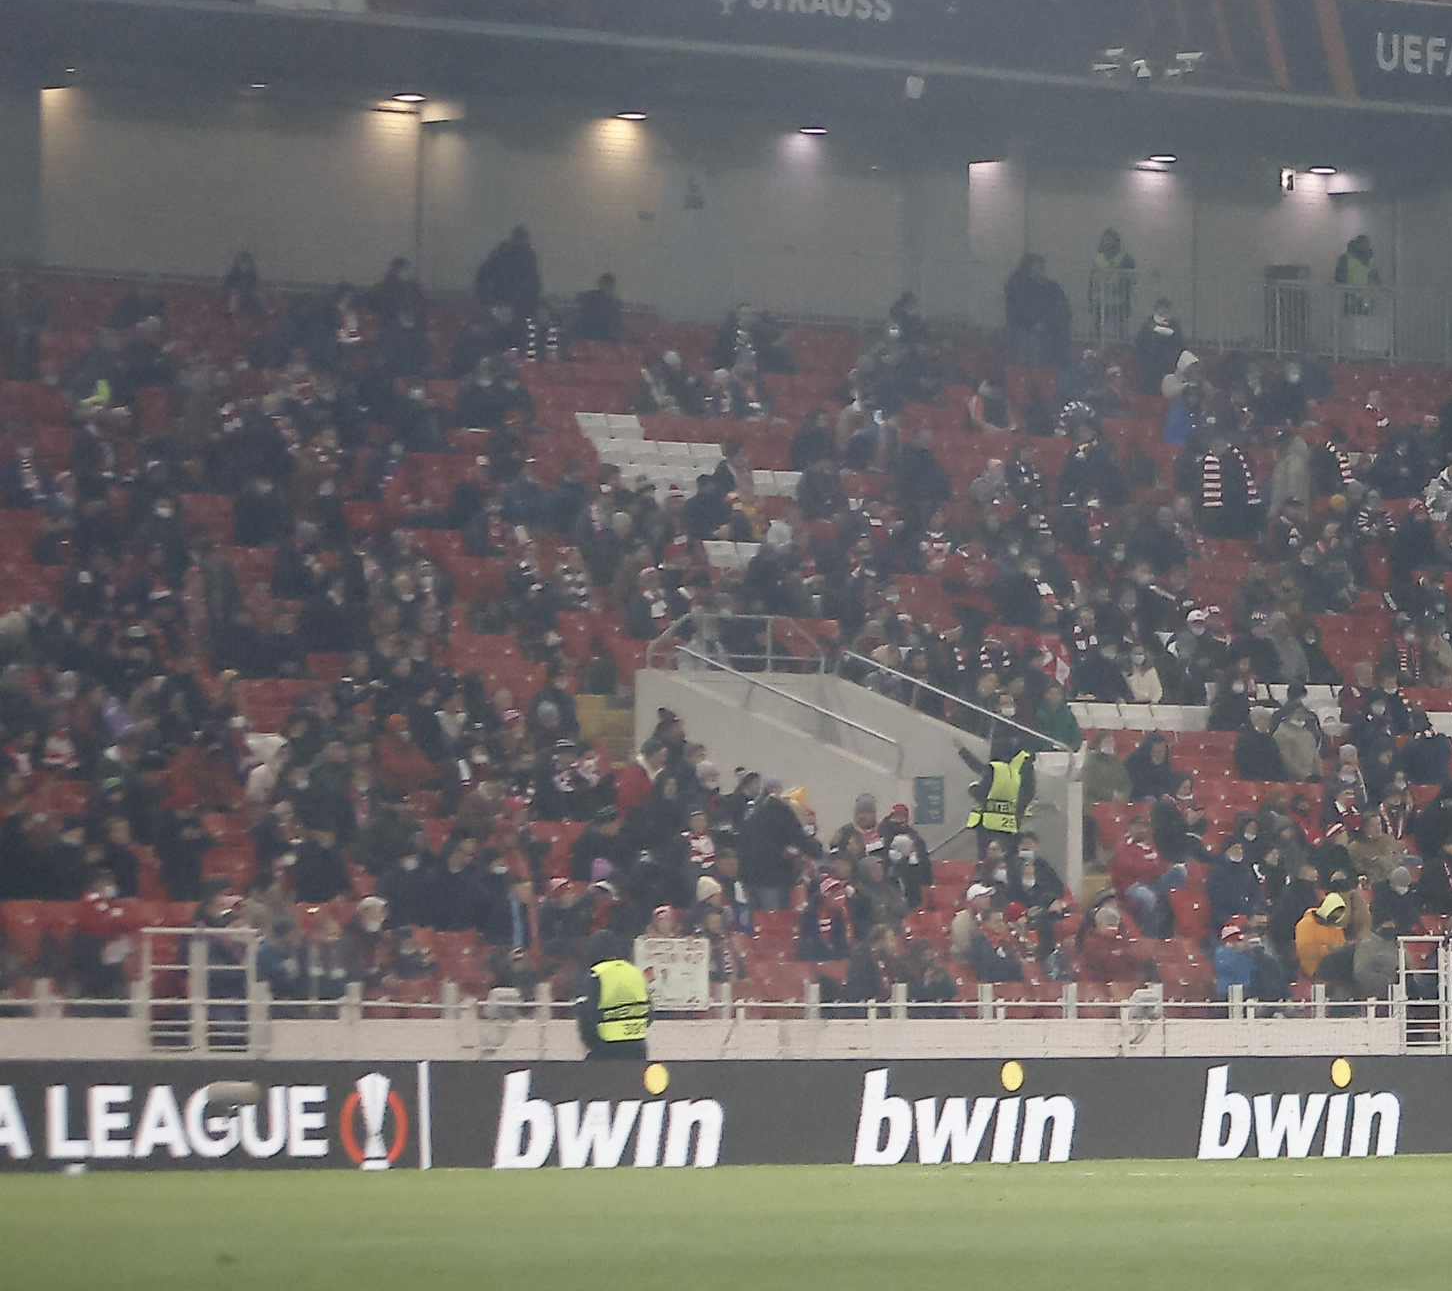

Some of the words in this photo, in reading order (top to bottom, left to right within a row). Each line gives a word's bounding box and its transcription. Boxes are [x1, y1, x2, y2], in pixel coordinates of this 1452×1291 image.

[47, 1083, 329, 1158] LEAGUE
[493, 1064, 724, 1170] bwin
[853, 1060, 1076, 1167] bwin
[1196, 1058, 1401, 1161] bwin
